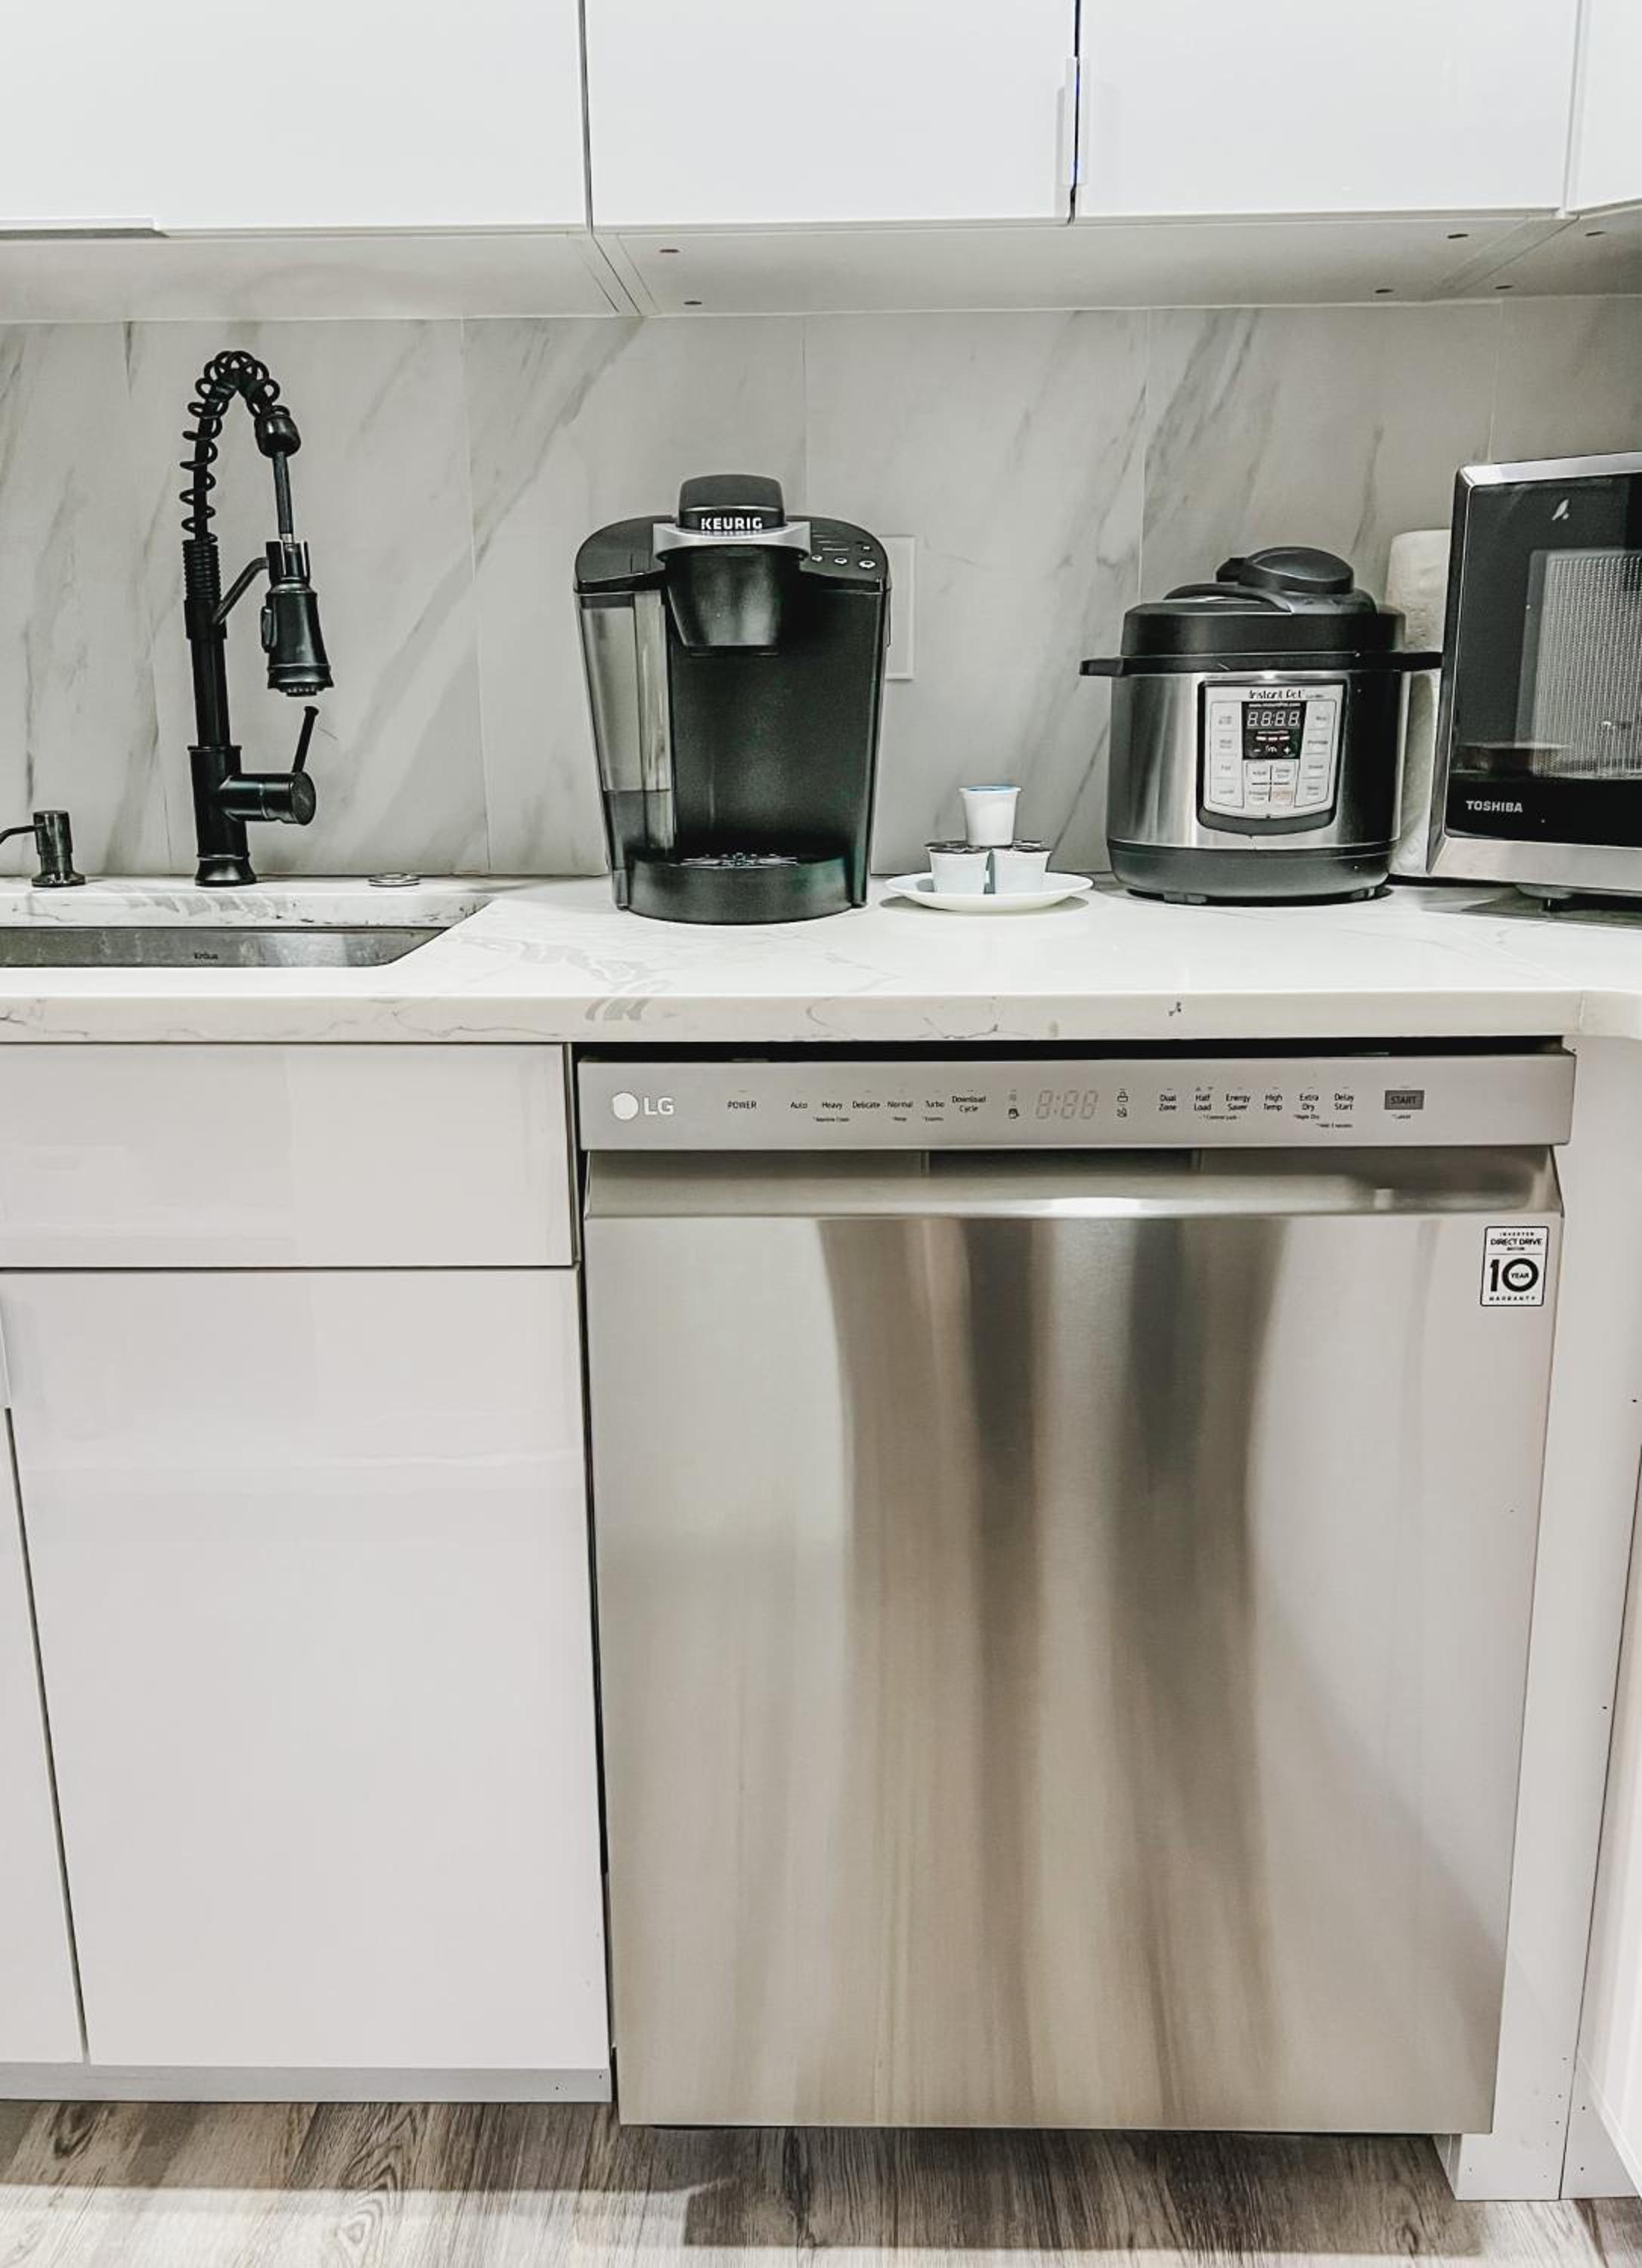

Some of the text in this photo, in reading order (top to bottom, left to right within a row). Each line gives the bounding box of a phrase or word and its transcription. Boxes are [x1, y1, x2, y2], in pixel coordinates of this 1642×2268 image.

[700, 516, 763, 531] KEURIG
[1248, 689, 1283, 699] Instant
[1286, 689, 1301, 699] Pot
[1466, 800, 1523, 813] TOSHIBA
[1225, 1093, 1250, 1103] Energy
[1265, 1094, 1283, 1103] High
[1300, 1093, 1318, 1101] Extra
[1334, 1093, 1354, 1102] Delay
[1390, 1095, 1416, 1105] START
[643, 1097, 674, 1115] LG
[727, 1101, 757, 1109] POWER
[822, 1101, 843, 1111] Heavy
[852, 1101, 880, 1109] Delicate
[959, 1105, 978, 1113] Cycle
[1194, 1103, 1211, 1111] Load
[1263, 1103, 1283, 1111] Temp
[1302, 1103, 1315, 1111] Dry
[1334, 1102, 1352, 1111] Start
[1489, 1258, 1539, 1293] 10
